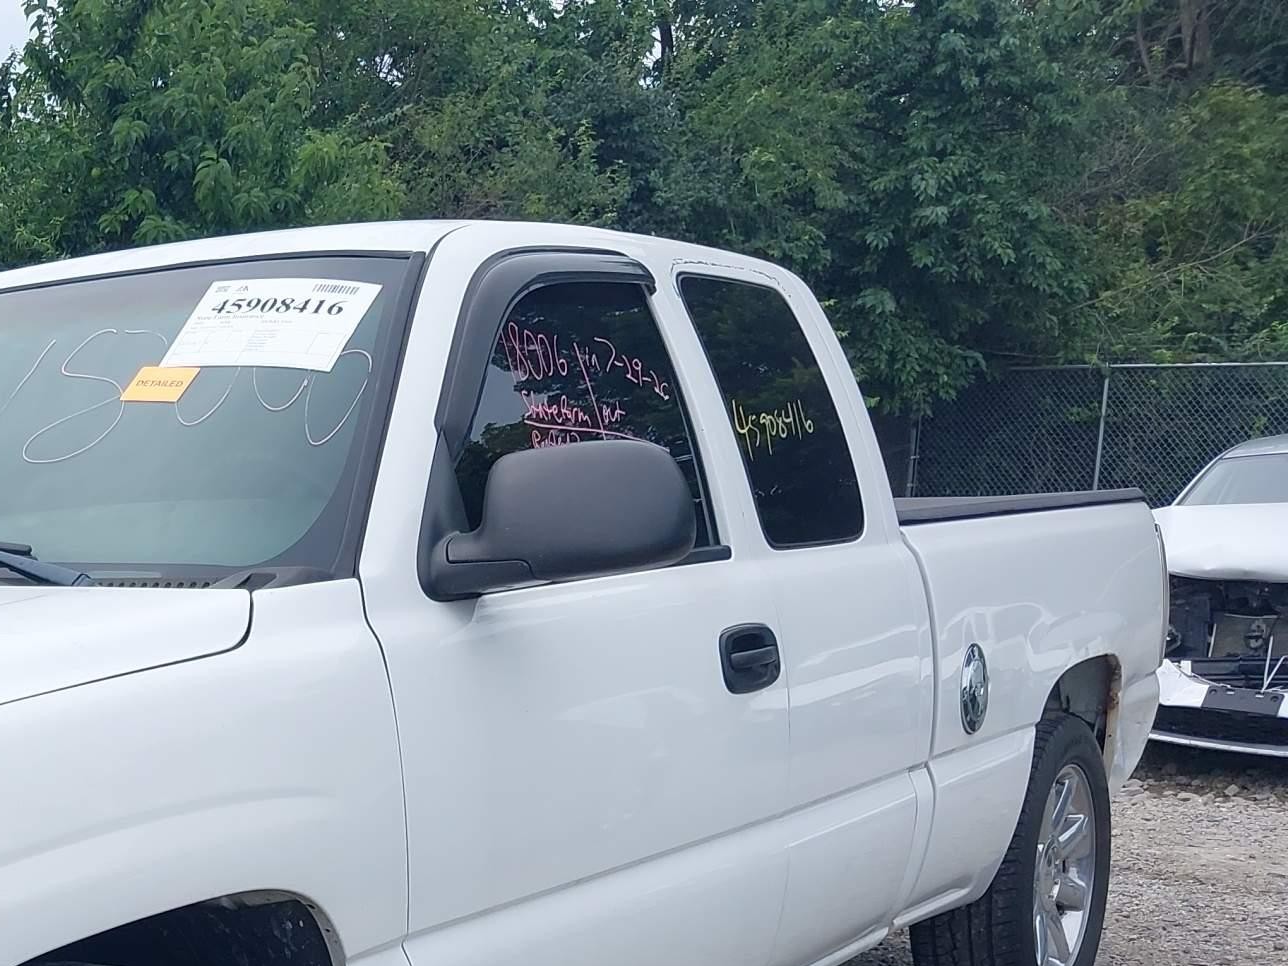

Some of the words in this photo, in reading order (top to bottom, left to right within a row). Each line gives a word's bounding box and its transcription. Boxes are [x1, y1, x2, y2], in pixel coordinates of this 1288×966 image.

[211, 297, 348, 316] 45908416
[135, 379, 184, 388] DETAILED
[732, 399, 814, 462] 45908416
